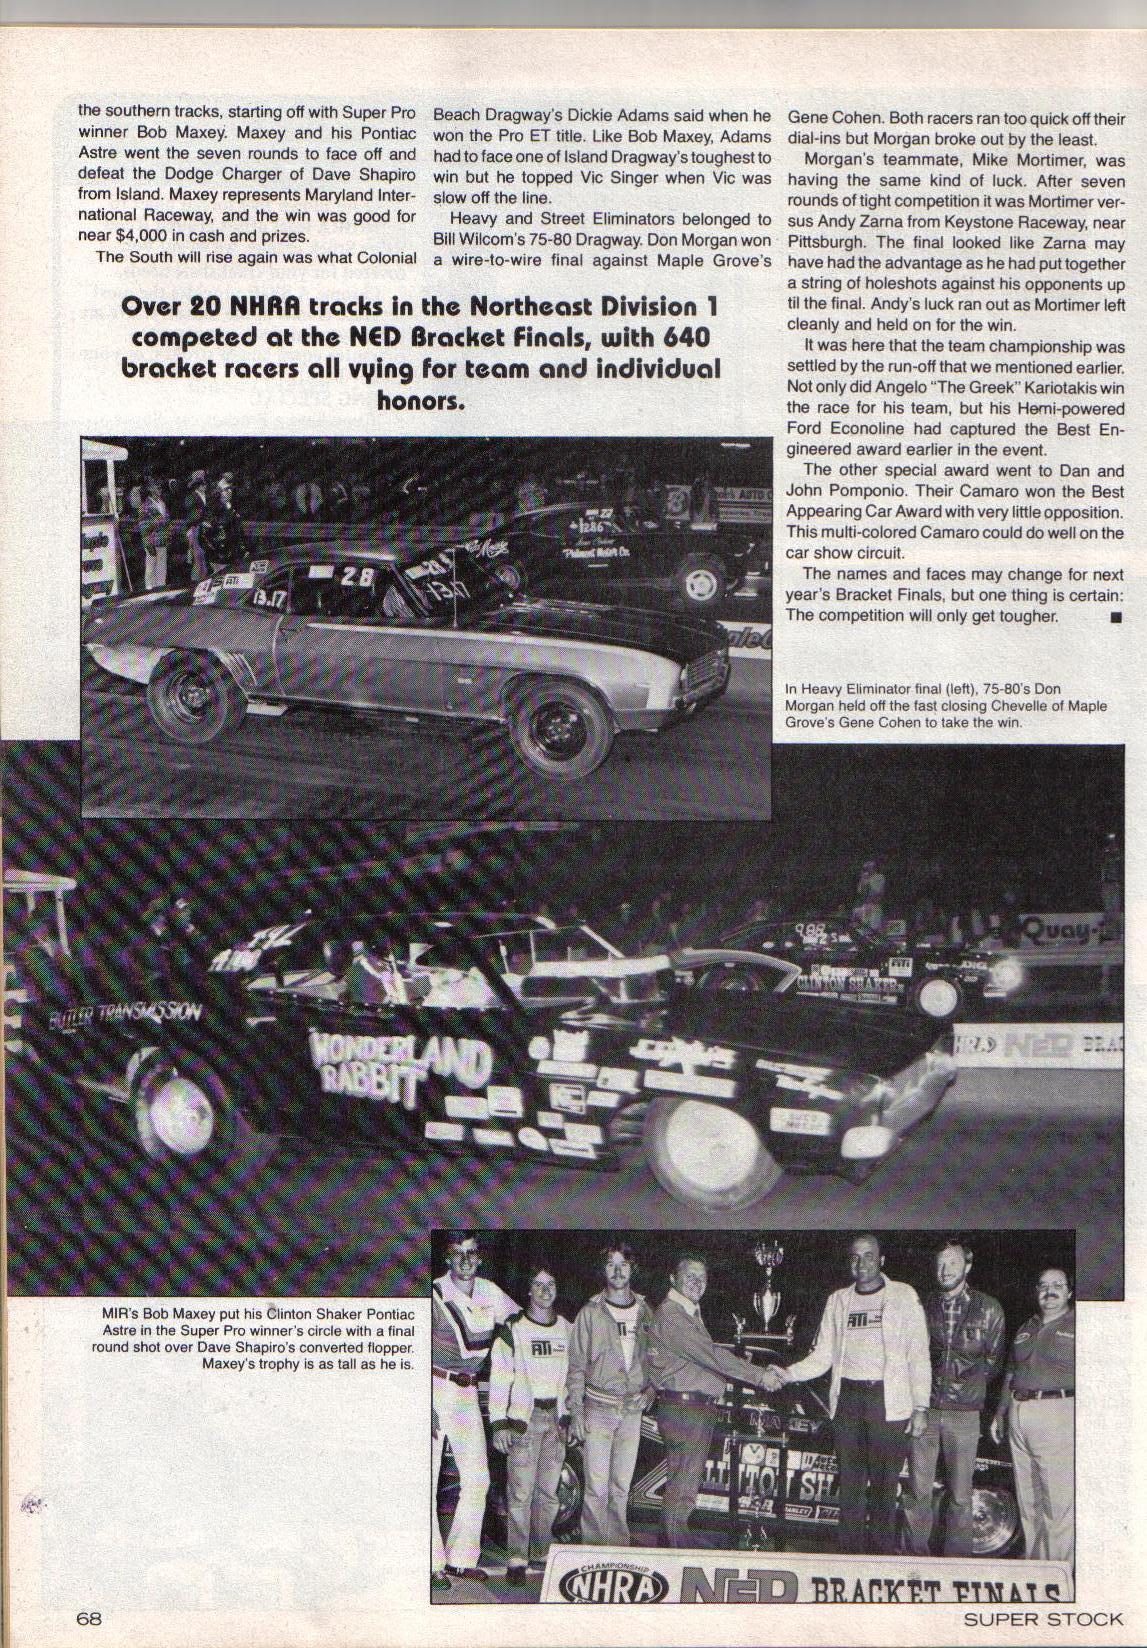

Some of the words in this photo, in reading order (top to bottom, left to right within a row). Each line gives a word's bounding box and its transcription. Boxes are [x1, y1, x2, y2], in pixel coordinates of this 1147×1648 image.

[78, 103, 102, 117] the
[105, 103, 171, 118] southern
[174, 104, 223, 120] tracks,
[228, 104, 283, 122] starting
[286, 104, 306, 119] off
[308, 105, 338, 119] with
[342, 105, 387, 122] Super
[391, 105, 416, 120] Pro
[433, 107, 481, 121] Beach
[485, 107, 563, 125] Dragway's
[567, 107, 613, 122] Dickie
[617, 108, 669, 122] Adams
[673, 108, 704, 123] said
[708, 108, 749, 123] when
[753, 109, 772, 123] he
[78, 230, 112, 242] near
[115, 227, 168, 244] $4,000
[172, 228, 185, 242] in
[189, 229, 225, 243] cash
[229, 228, 257, 243] and
[261, 229, 310, 247] prizes.
[788, 234, 867, 252] Pittsburgh.
[875, 235, 905, 249] The
[913, 235, 944, 249] final
[952, 235, 1001, 249] looked
[1009, 235, 1035, 250] like
[1042, 236, 1087, 250] Zarna
[1094, 239, 1126, 253] may
[121, 295, 182, 317] Over
[190, 295, 222, 317] 20
[230, 295, 301, 317] NHRA
[309, 295, 384, 317] tracks
[392, 295, 414, 316] in
[421, 295, 461, 317] the
[470, 295, 593, 317] Northeast
[601, 295, 697, 317] Division
[707, 295, 717, 317] 1
[131, 325, 258, 353] competed
[266, 328, 293, 348] at
[301, 325, 341, 347] the
[349, 325, 402, 347] NED
[411, 325, 505, 348] Bracket
[513, 325, 592, 352] Finals,
[601, 325, 655, 348] with
[663, 326, 711, 348] 640
[121, 356, 217, 379] bracket
[225, 362, 300, 379] racers
[307, 356, 340, 379] all
[348, 356, 414, 385] vying
[422, 356, 458, 379] for
[465, 359, 530, 379] team
[538, 357, 588, 379] and
[596, 356, 721, 379] individual
[377, 389, 466, 411] honors.
[785, 548, 810, 560] car
[813, 546, 853, 560] show
[857, 546, 902, 560] circuit.
[341, 566, 375, 588] 28
[785, 683, 797, 695] In
[801, 683, 843, 697] Heavy
[846, 683, 912, 695] Eliminator
[915, 683, 942, 695] final
[946, 682, 979, 697] (left),
[983, 682, 1031, 695] 75-80's
[1034, 682, 1061, 695] Don
[785, 699, 835, 715] Morgan
[838, 699, 866, 712] held
[869, 699, 886, 712] off
[889, 699, 910, 712] the
[913, 699, 938, 712] fast
[941, 700, 987, 715] closing
[991, 699, 1048, 712] Chevelle
[1051, 699, 1065, 712] of
[1068, 699, 1108, 714] Maple
[785, 716, 835, 728] Grove's
[838, 716, 875, 729] Gene
[878, 716, 921, 729] Cohen
[925, 717, 938, 728] to
[941, 716, 969, 729] take
[972, 716, 994, 729] the
[997, 716, 1019, 728] win.
[797, 976, 847, 991] CLINTON
[848, 977, 898, 992] SHAKER
[97, 1001, 203, 1021] TRANSMISSION
[308, 1026, 494, 1090] WONDERLAND
[320, 1060, 429, 1111] RABBIT
[102, 1307, 139, 1320] MIR's
[143, 1307, 169, 1320] Bob
[172, 1307, 216, 1323] Maxey
[219, 1308, 240, 1323] put
[244, 1307, 263, 1320] his
[266, 1307, 312, 1320] Clinton
[316, 1307, 363, 1321] Shaker
[366, 1307, 415, 1321] Pontiac
[102, 1324, 137, 1337] Astre
[140, 1324, 152, 1336] in
[155, 1324, 176, 1336] the
[180, 1324, 220, 1339] Super
[223, 1324, 246, 1337] Pro
[249, 1324, 304, 1337] winner's
[307, 1325, 342, 1337] circle
[345, 1325, 372, 1337] with
[376, 1327, 385, 1337] a
[388, 1325, 415, 1337] final
[91, 1340, 129, 1353] round
[133, 1340, 161, 1353] shot
[164, 1343, 194, 1353] over
[197, 1340, 231, 1353] Dave
[235, 1340, 296, 1356] Shapiro's
[299, 1341, 364, 1354] converted
[367, 1341, 414, 1357] flopper.
[202, 1357, 256, 1373] Maxey's
[258, 1357, 300, 1373] trophy
[304, 1357, 315, 1370] is
[318, 1360, 334, 1370] as
[337, 1357, 357, 1370] tall
[360, 1360, 376, 1370] as
[380, 1358, 397, 1370] he
[400, 1358, 411, 1370] is.
[581, 1562, 650, 1573] CHAMPIONSHIP
[572, 1570, 656, 1603] NHRA
[681, 1566, 799, 1603] NED
[811, 1576, 942, 1603] BRACKET
[76, 1611, 103, 1626] 68
[964, 1612, 1039, 1627] SUPER
[1047, 1612, 1124, 1627] STOCK
